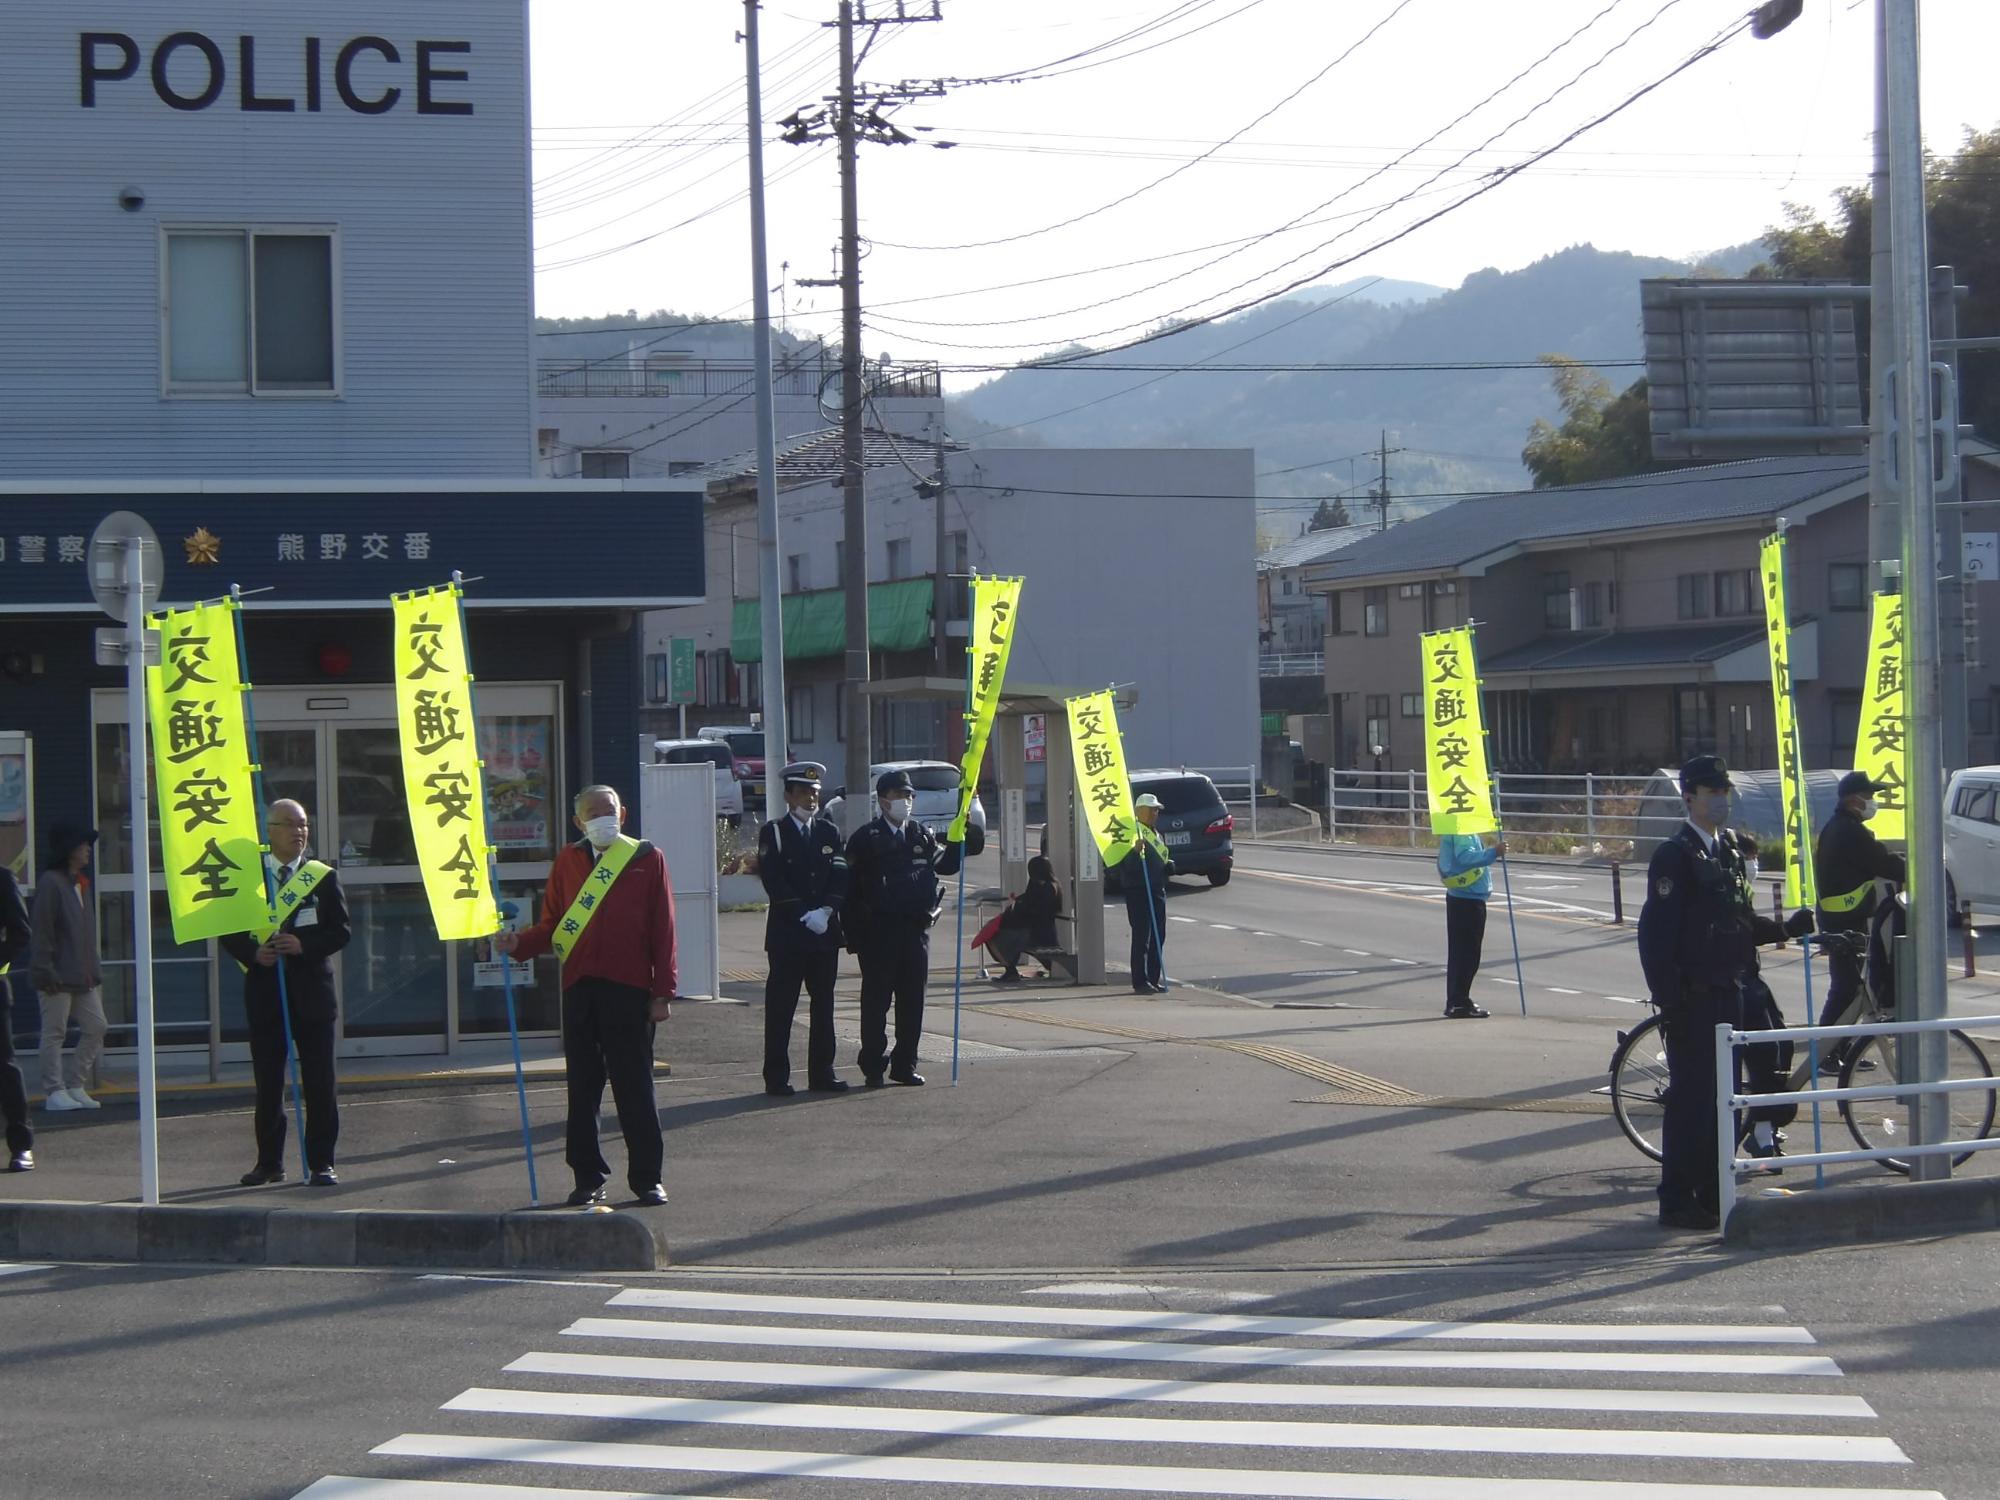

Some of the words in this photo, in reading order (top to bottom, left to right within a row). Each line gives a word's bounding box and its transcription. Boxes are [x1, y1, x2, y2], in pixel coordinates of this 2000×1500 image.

[80, 31, 474, 115] POLICE
[278, 532, 431, 561] 熊野交番
